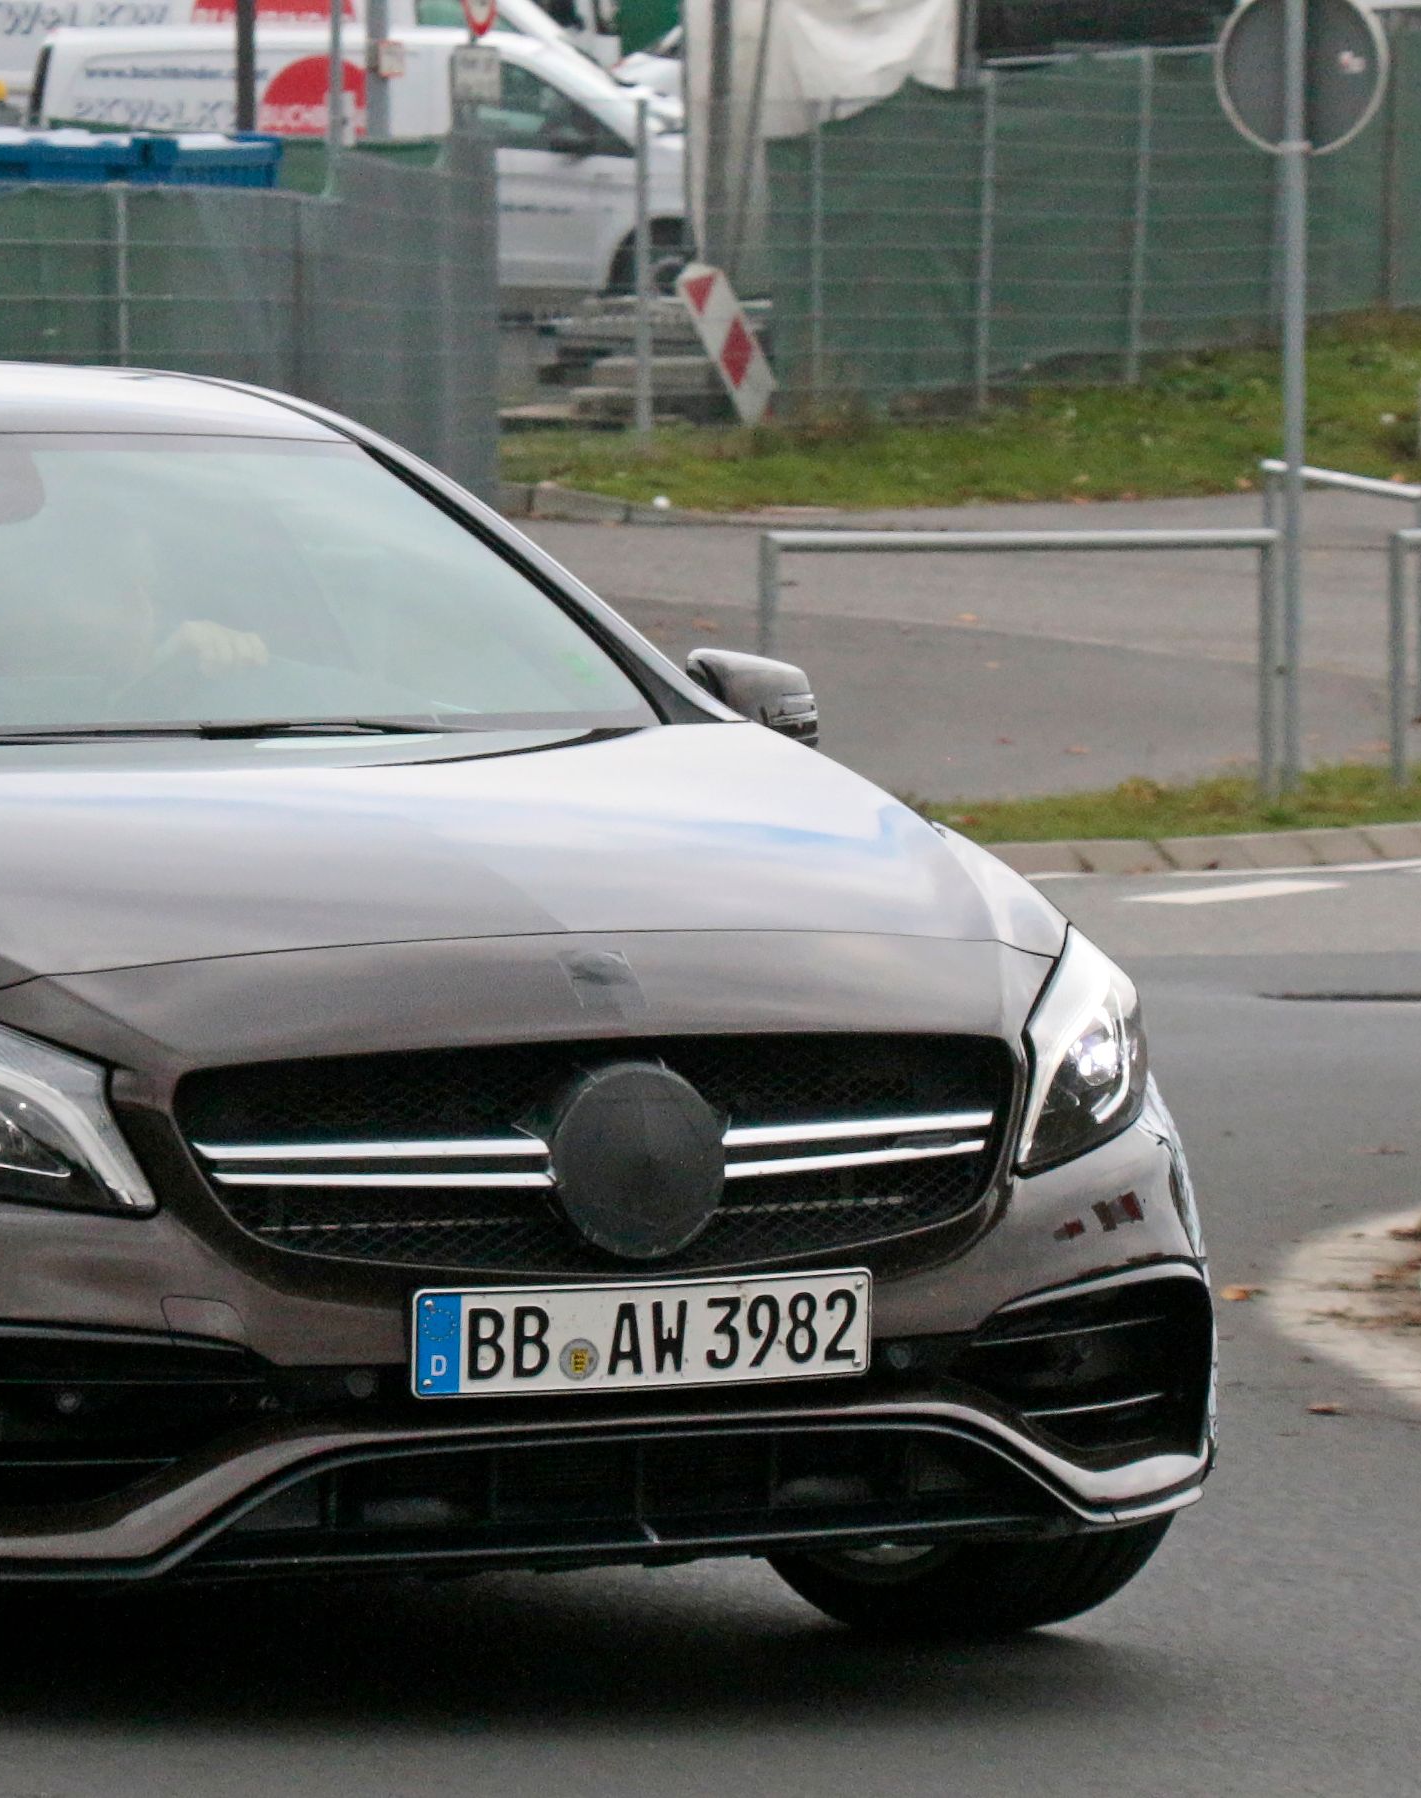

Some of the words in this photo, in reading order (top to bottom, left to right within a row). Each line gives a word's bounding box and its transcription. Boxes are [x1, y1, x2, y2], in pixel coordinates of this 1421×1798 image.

[467, 1306, 550, 1380] BB
[607, 1300, 688, 1375] AW
[705, 1289, 857, 1369] 3982
[430, 1355, 447, 1377] D
